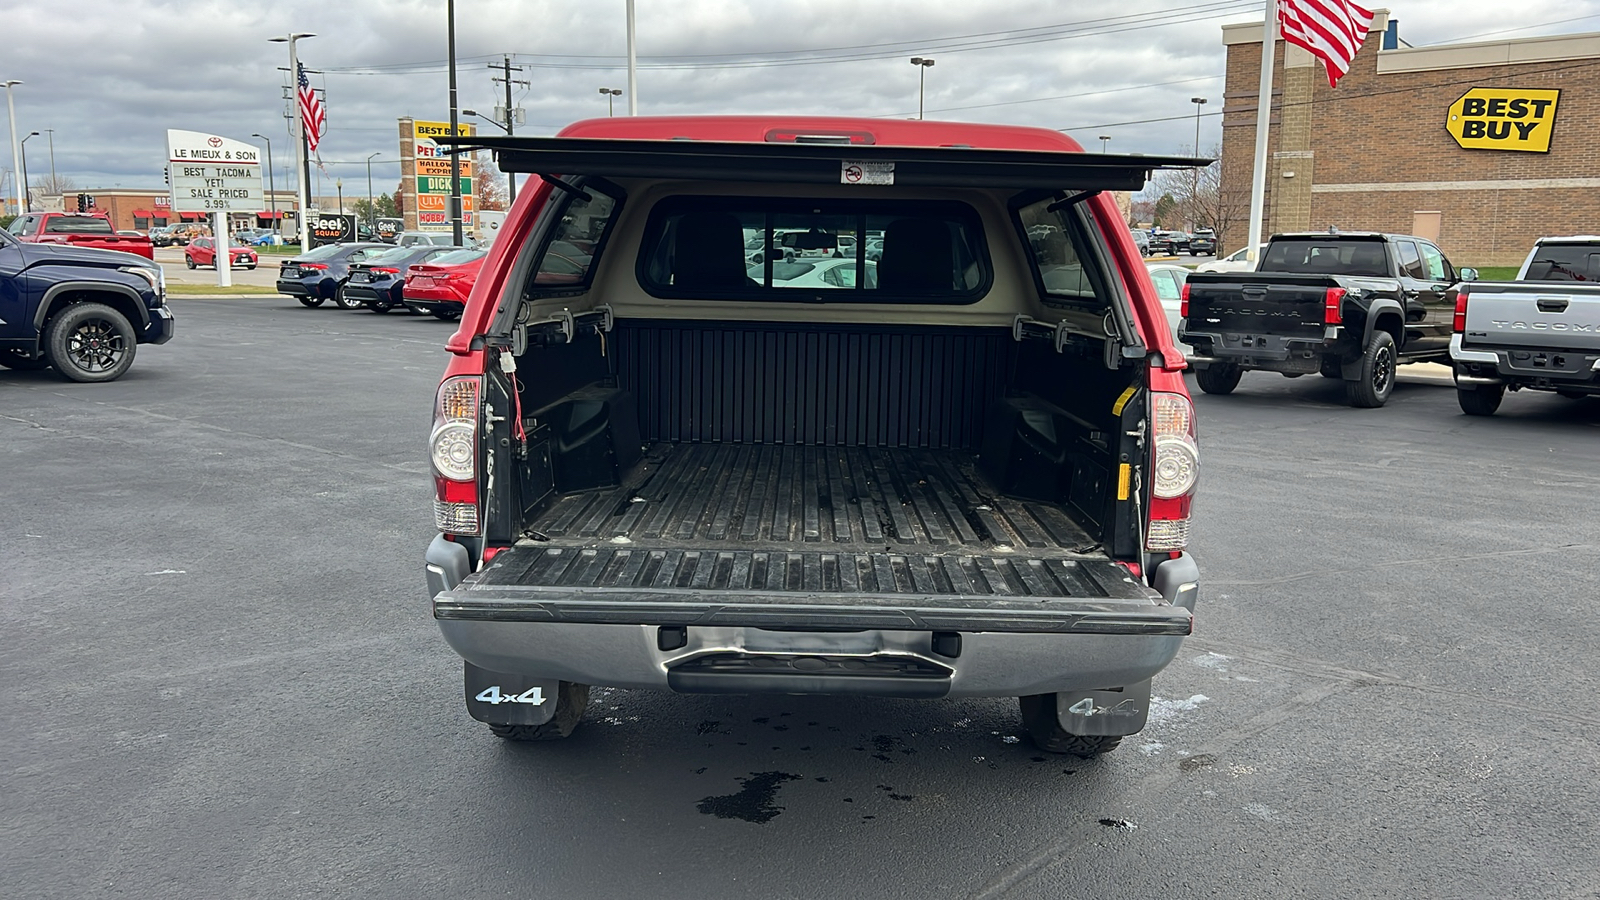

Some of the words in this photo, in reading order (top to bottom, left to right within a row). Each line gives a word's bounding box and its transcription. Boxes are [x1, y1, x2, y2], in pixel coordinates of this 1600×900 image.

[1462, 98, 1552, 119] BEST
[418, 126, 443, 135] BEST
[444, 128, 466, 136] BY
[1462, 120, 1540, 141] BUY
[174, 149, 187, 158] LE
[191, 150, 221, 159] MIEUX
[224, 150, 232, 159] &
[235, 151, 256, 160] SON
[419, 160, 469, 168] HALLOWEN
[184, 167, 206, 177] BEST
[215, 168, 252, 178] TACOMA
[204, 178, 224, 188] YET!
[190, 188, 213, 198] SALE
[219, 189, 249, 199] PRICED
[155, 196, 167, 206] OLD
[204, 199, 231, 209] 3.99%
[422, 196, 444, 206] ULTA
[419, 213, 445, 223] HOBBY
[1208, 306, 1302, 318] TACOMA
[474, 685, 547, 706] 4x4
[1068, 697, 1139, 717] 4x4
